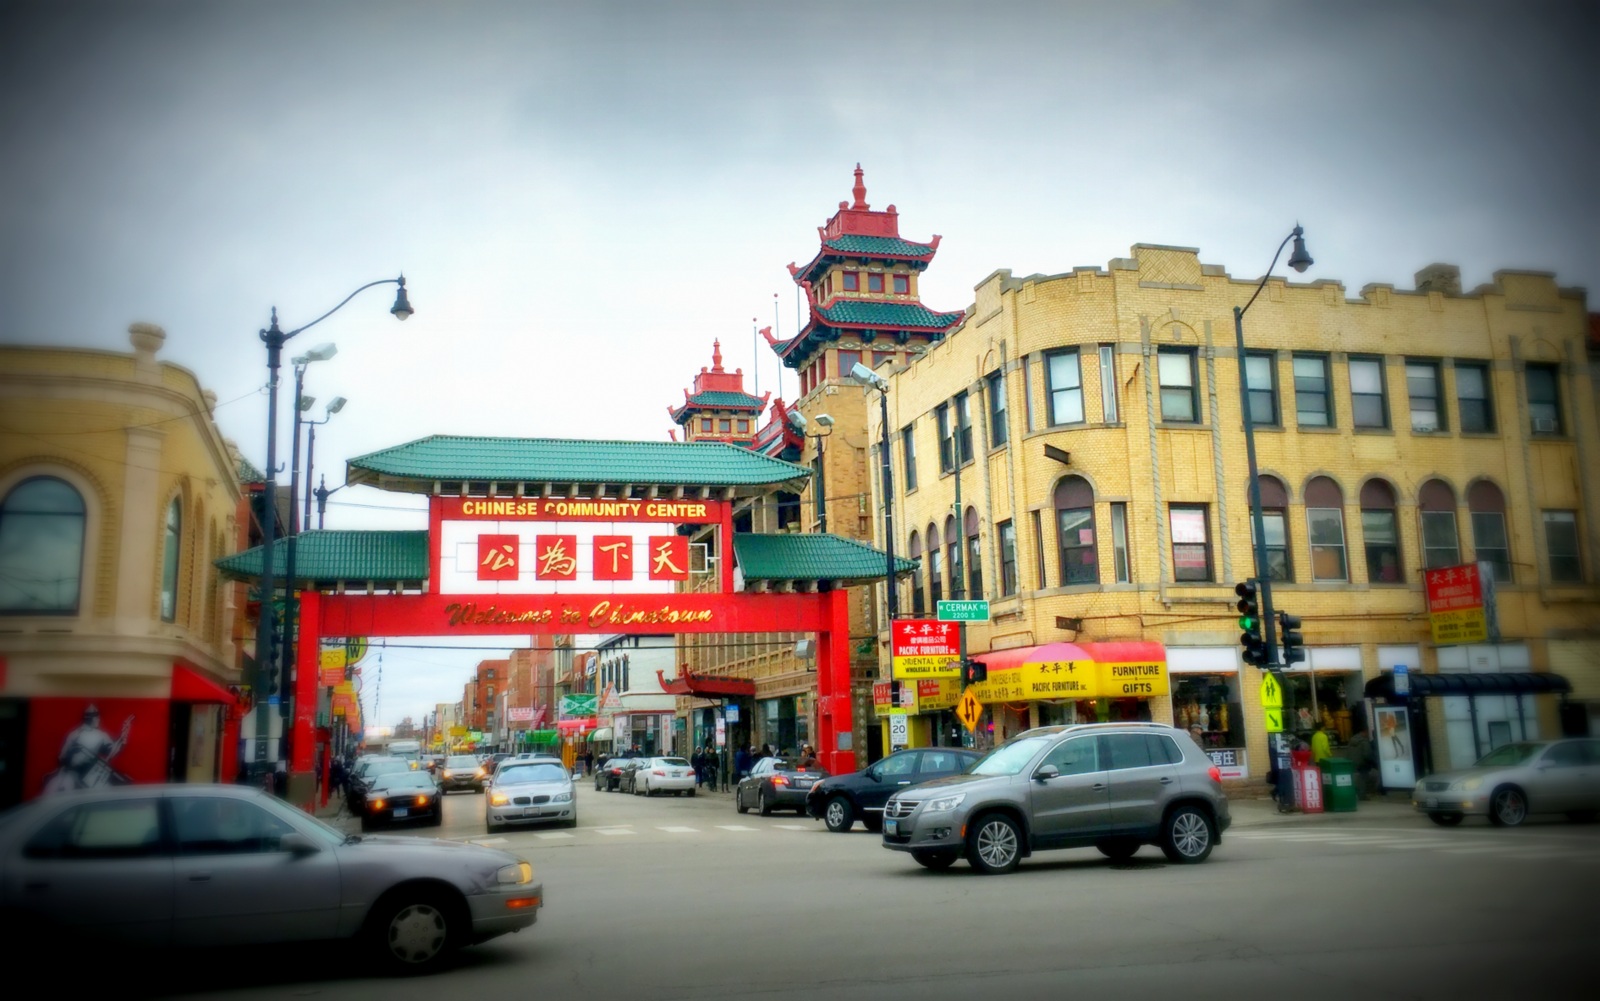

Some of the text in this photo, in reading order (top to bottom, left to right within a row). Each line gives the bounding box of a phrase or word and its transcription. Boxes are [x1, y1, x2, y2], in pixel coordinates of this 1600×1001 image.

[463, 501, 706, 517] CHINESE COMMUNITY CENTER
[946, 603, 978, 611] CERMAK
[446, 600, 713, 628] Welcome to Chinatown
[903, 623, 952, 635] 太平洋
[898, 646, 918, 655] PACIFIC
[920, 645, 949, 655] FURNITURE
[1040, 661, 1076, 675] 太平洋
[1112, 665, 1159, 677] FURNITURE
[1032, 681, 1050, 693] PACIFIC
[1052, 680, 1079, 692] FURNITURE
[1122, 682, 1152, 694] GIFTS
[892, 725, 905, 733] 20
